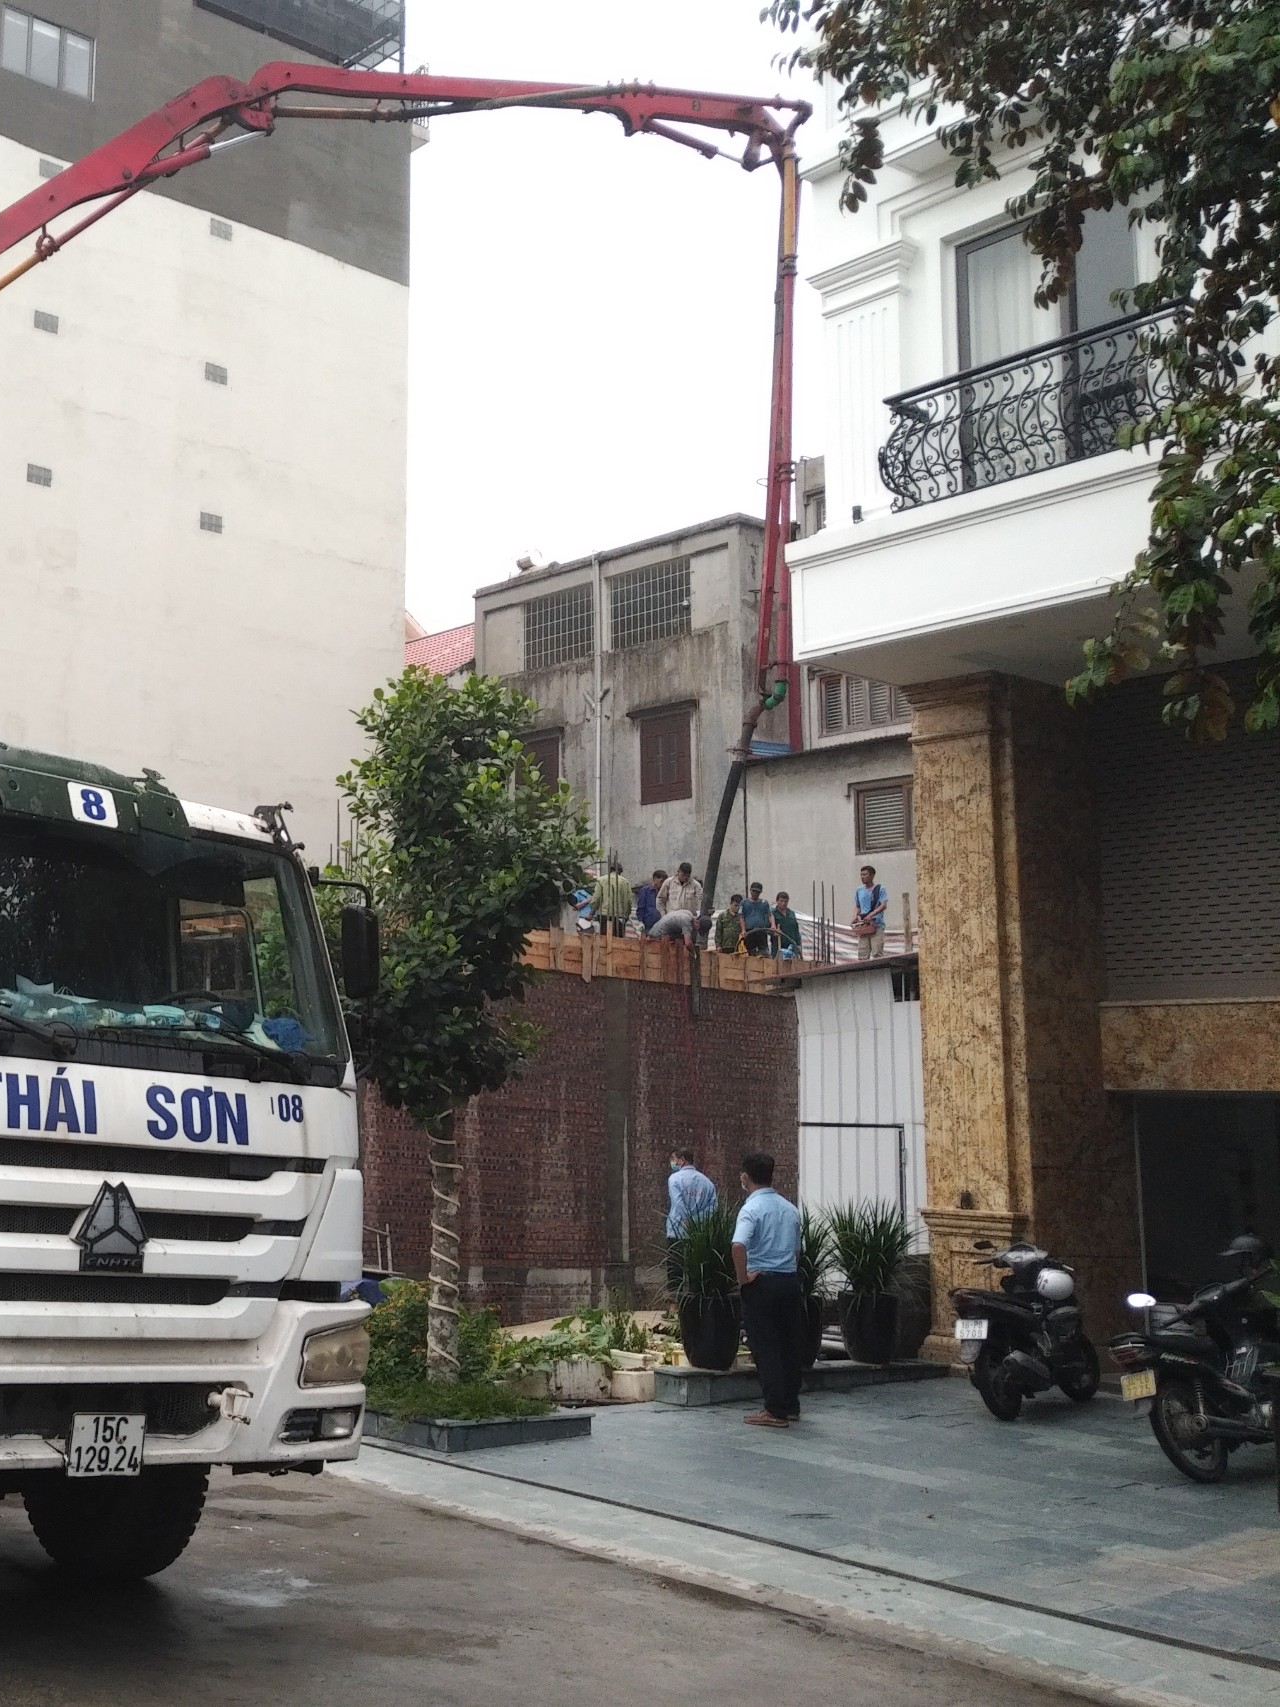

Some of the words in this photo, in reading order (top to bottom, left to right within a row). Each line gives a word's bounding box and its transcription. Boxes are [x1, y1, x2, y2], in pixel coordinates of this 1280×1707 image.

[80, 788, 107, 821] 8
[145, 1085, 249, 1146] SƠN
[277, 1093, 304, 1123] 08
[86, 1257, 139, 1267] CNHTC
[93, 1416, 129, 1444] 15C
[74, 1445, 139, 1473] 129.24
